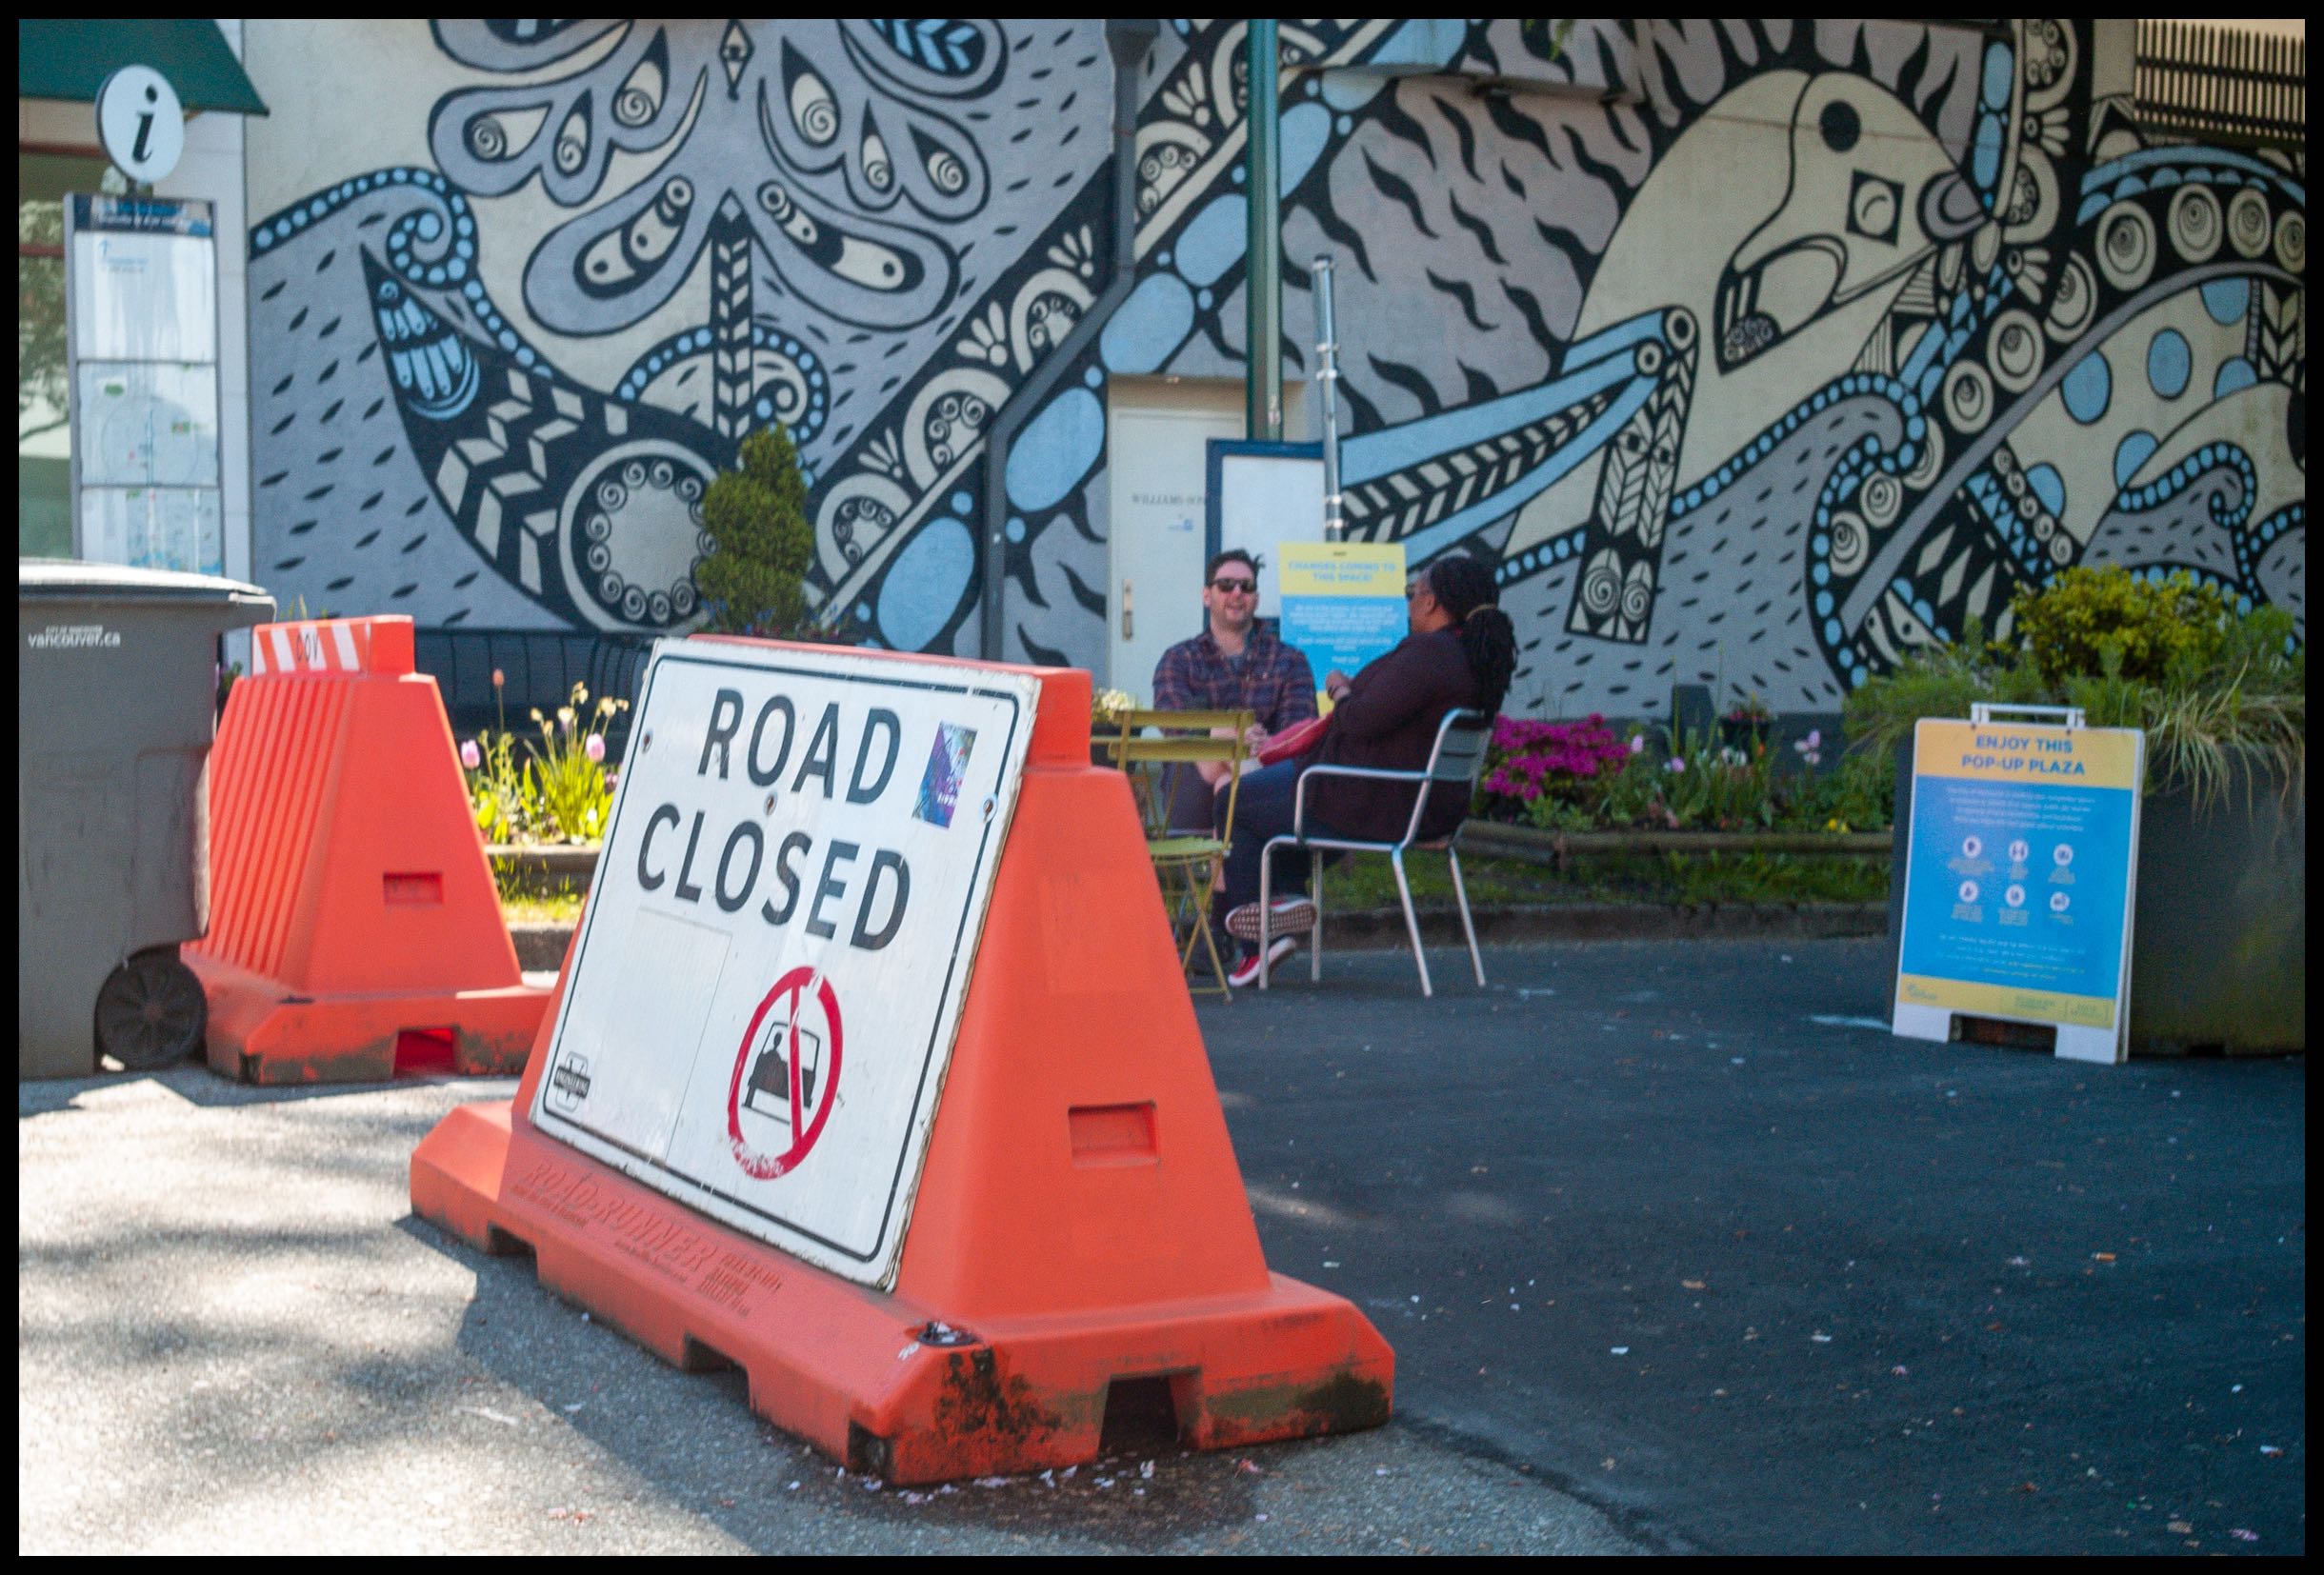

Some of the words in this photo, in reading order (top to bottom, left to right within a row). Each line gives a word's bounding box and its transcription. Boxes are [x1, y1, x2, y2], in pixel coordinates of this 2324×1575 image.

[28, 631, 121, 648] vancouver.ca
[296, 632, 319, 663] COV
[696, 688, 901, 806] ROAD
[1975, 735, 2030, 751] ENJOY
[2036, 738, 2074, 754] THIS
[1961, 755, 2024, 771] POP-UP
[2029, 758, 2086, 775] PLAZA
[637, 802, 911, 951] CLOSED
